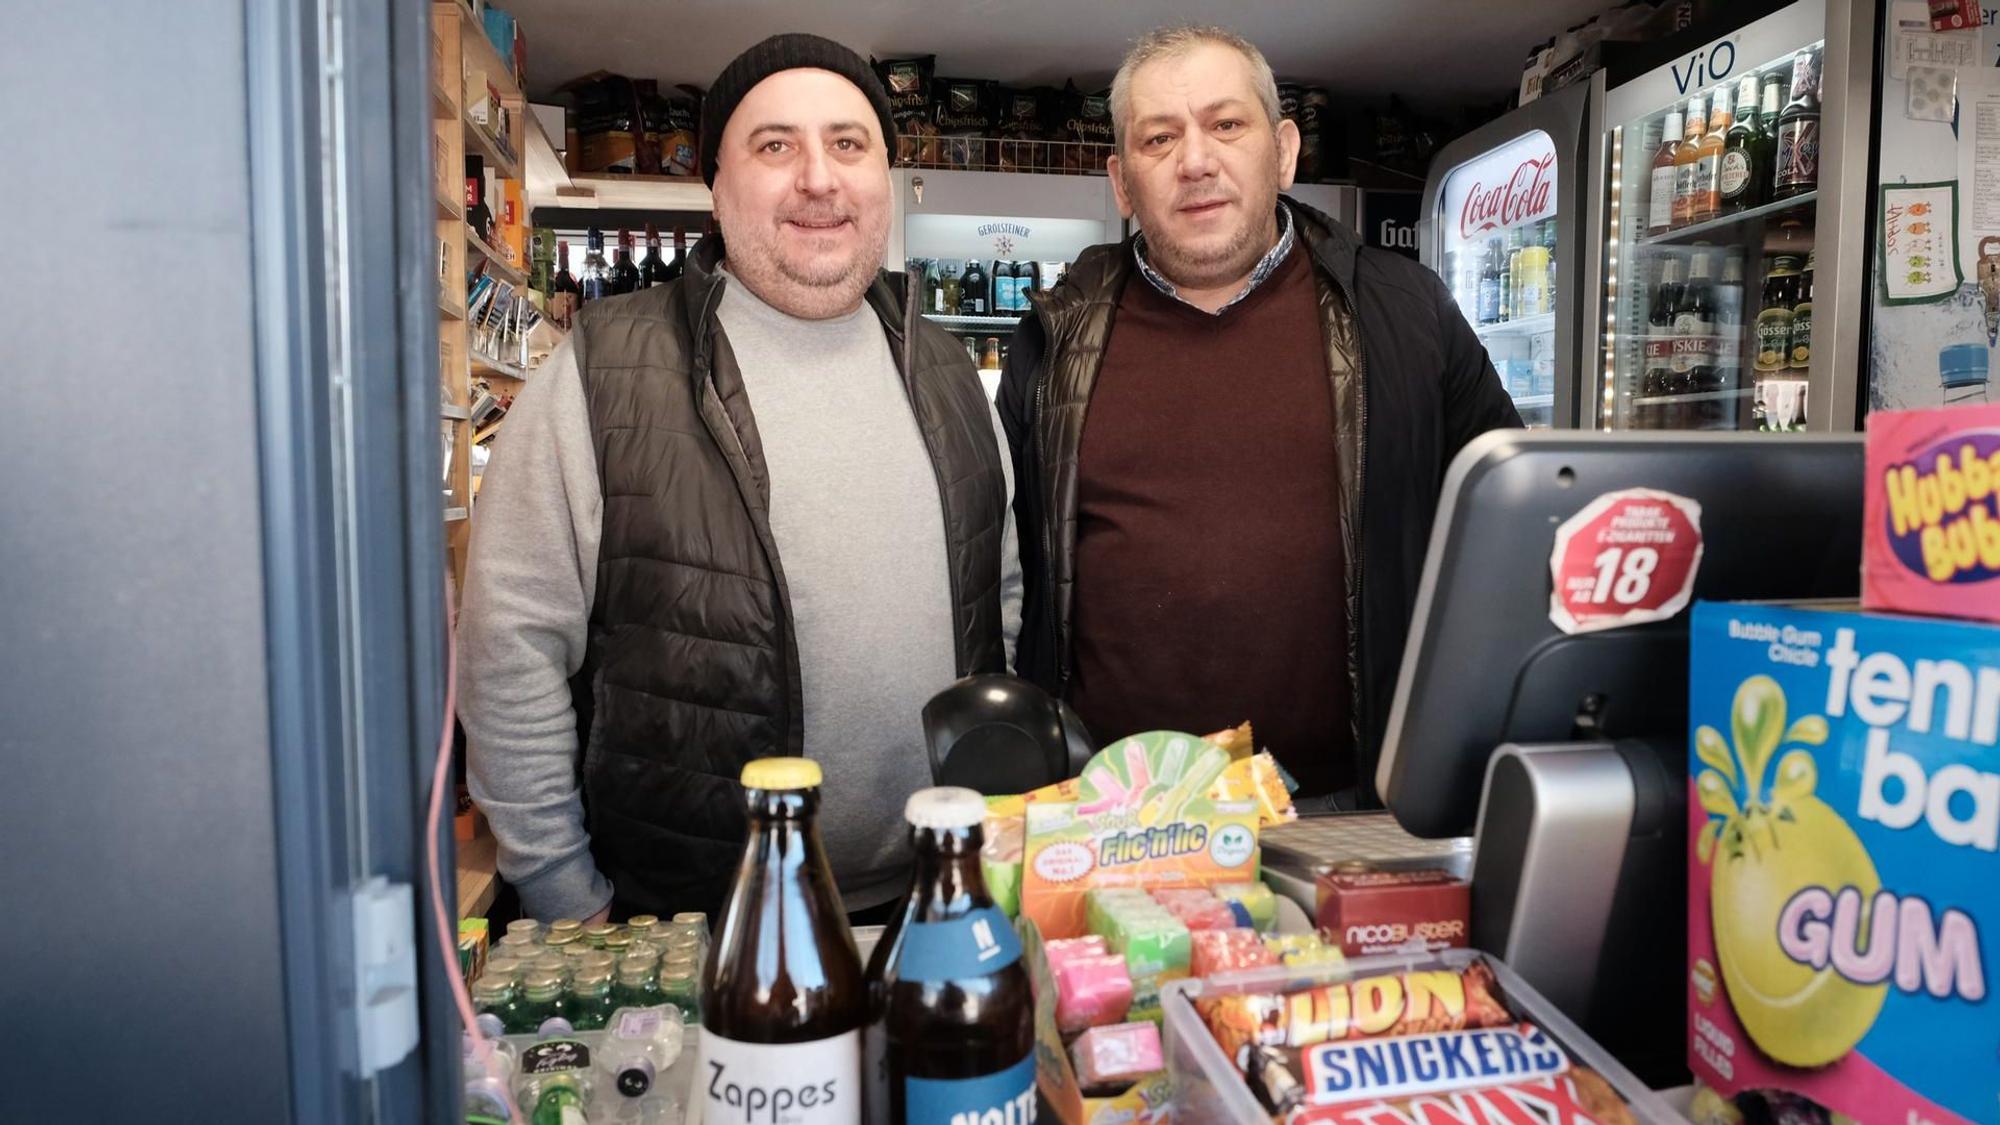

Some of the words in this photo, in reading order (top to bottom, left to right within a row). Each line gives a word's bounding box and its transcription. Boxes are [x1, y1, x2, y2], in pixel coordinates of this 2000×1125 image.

[1671, 40, 1735, 95] ViO
[1461, 152, 1557, 239] Coca-Cola
[977, 222, 1031, 239] GEROLSTEINER
[1592, 546, 1659, 605] 18
[1728, 619, 1779, 643] Bubble
[1780, 625, 1822, 648] Gum
[1778, 885, 1986, 1001] GUM
[1287, 970, 1466, 1047] LION
[708, 1059, 837, 1124] Zappes
